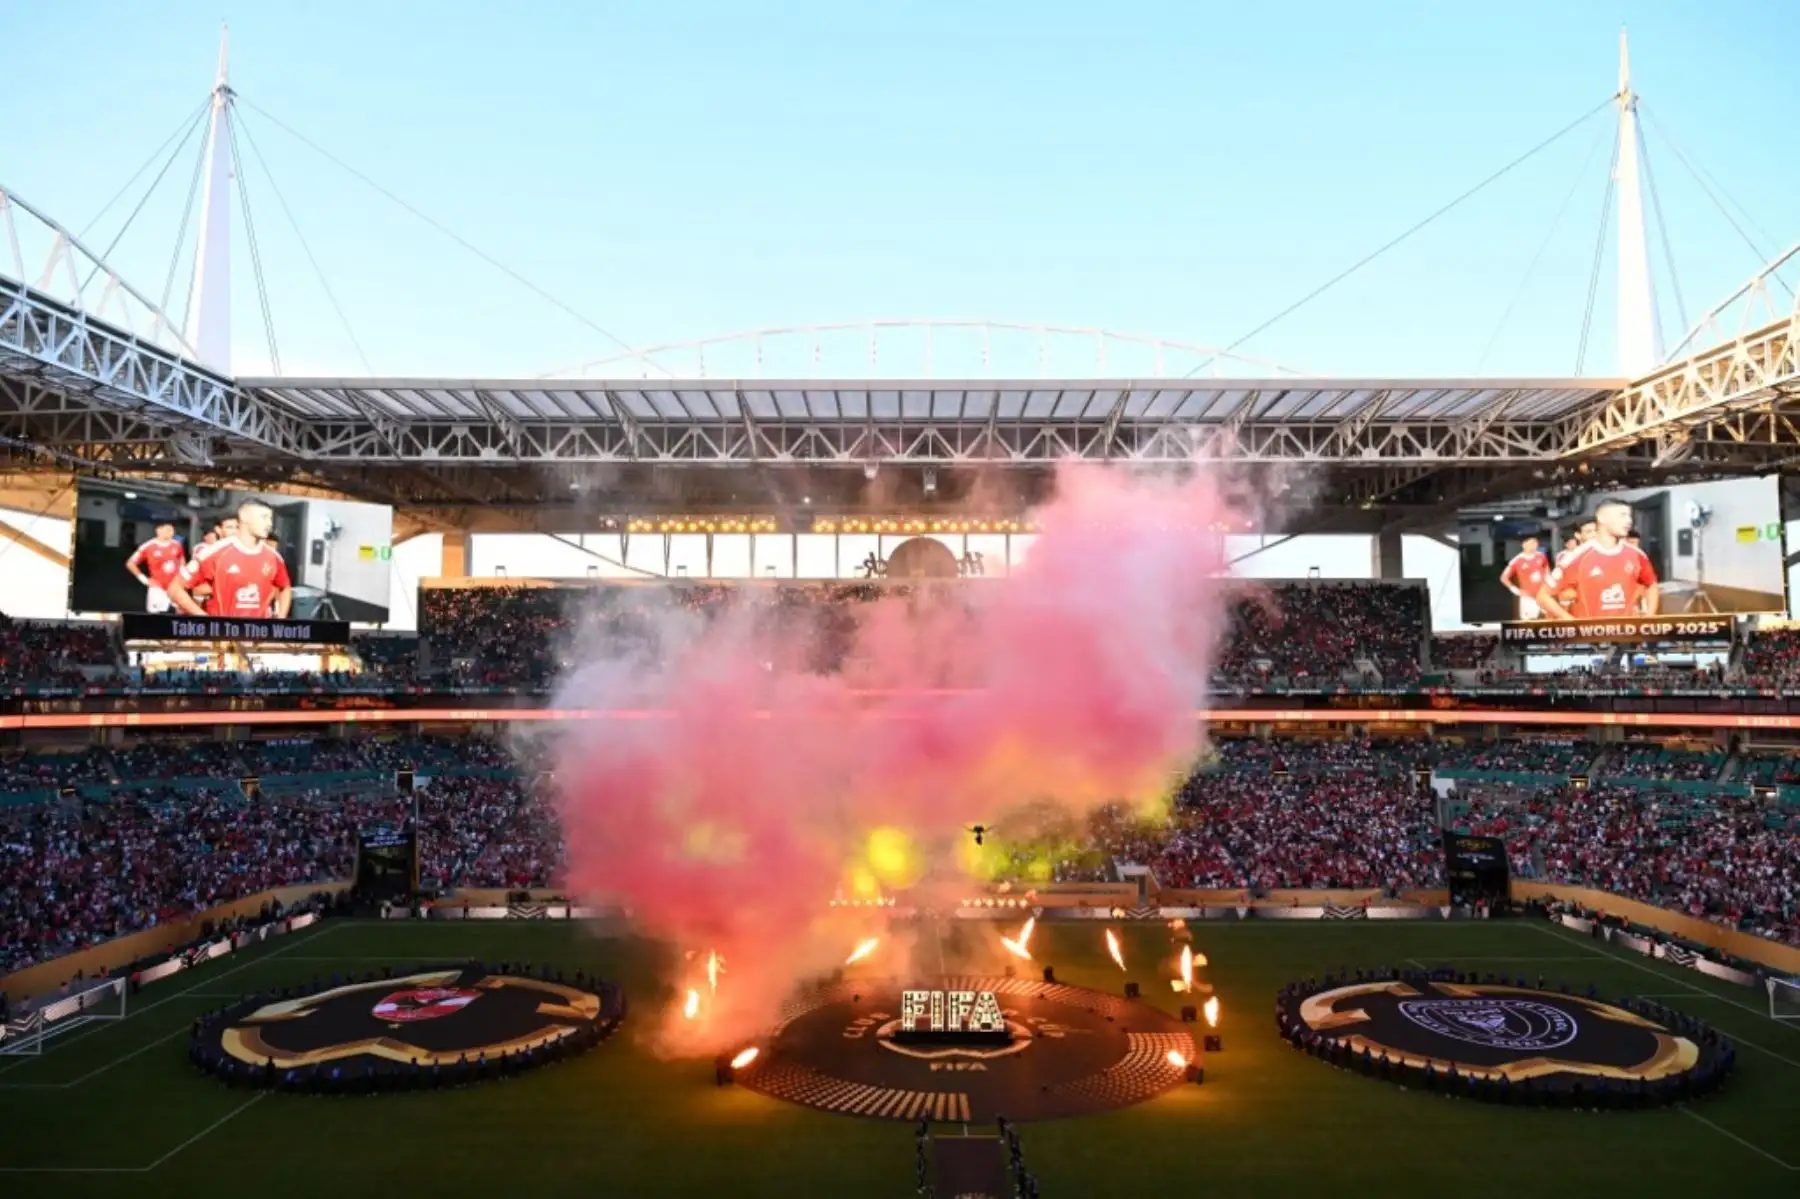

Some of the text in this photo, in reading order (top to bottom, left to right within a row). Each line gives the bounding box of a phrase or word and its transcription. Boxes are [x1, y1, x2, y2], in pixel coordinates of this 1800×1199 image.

[172, 620, 311, 639] Take It To The World
[1505, 628, 1536, 640] FIFA
[1538, 627, 1576, 639] CLUB
[1579, 624, 1637, 637] WORLD
[1639, 623, 1672, 635] CUP
[902, 990, 1006, 1032] FIFA
[929, 1062, 988, 1072] FIFA
